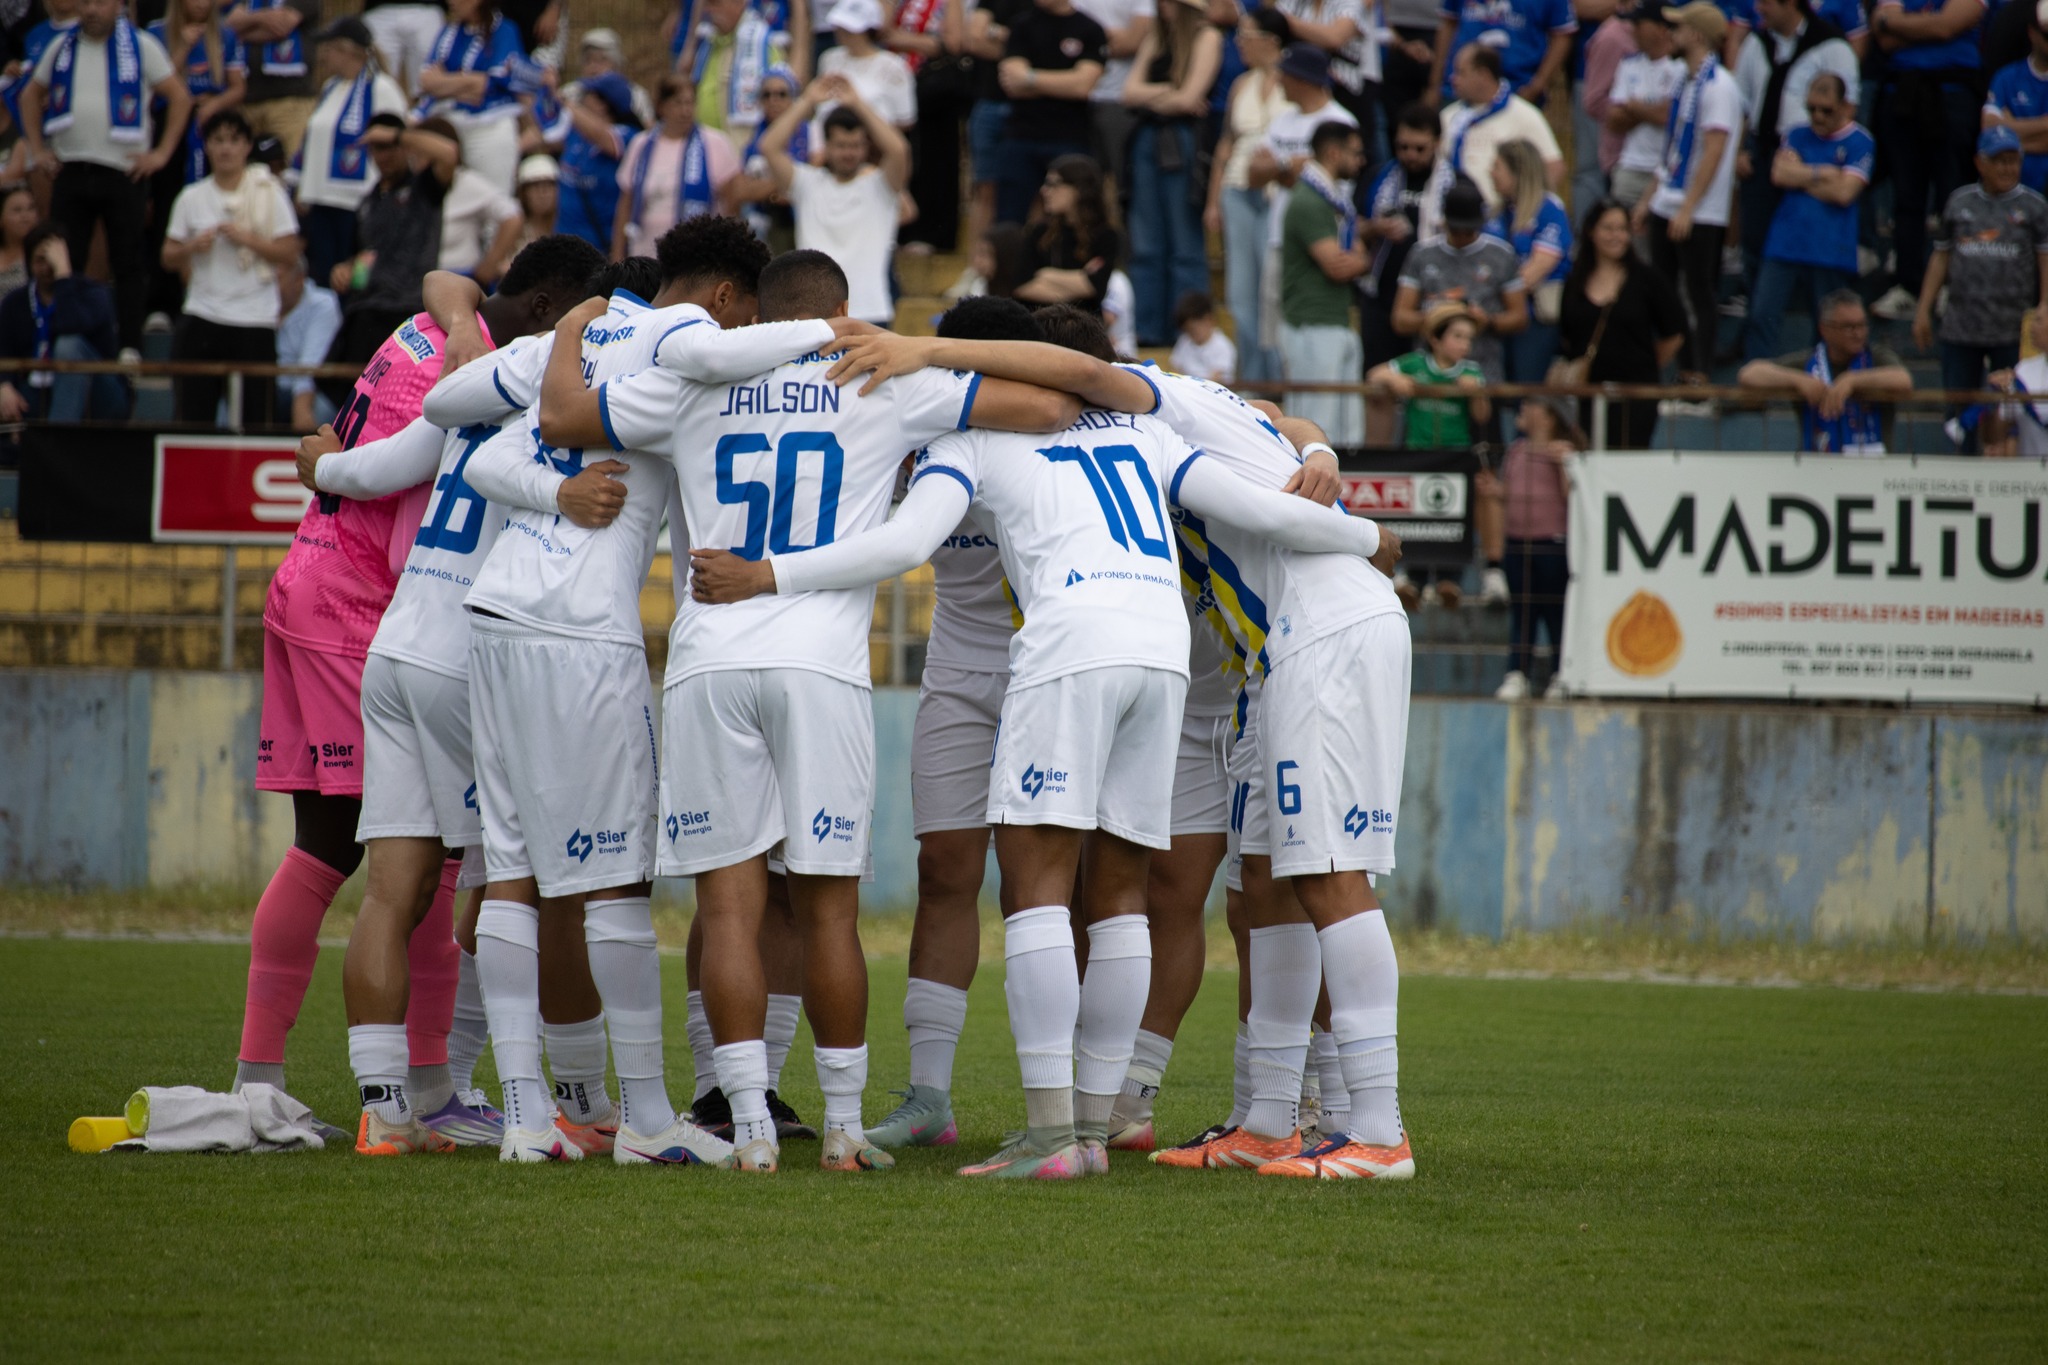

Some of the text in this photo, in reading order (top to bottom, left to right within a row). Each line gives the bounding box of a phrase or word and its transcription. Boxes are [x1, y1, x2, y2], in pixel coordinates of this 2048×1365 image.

[719, 378, 840, 416] JAÍLSON
[715, 431, 844, 562] 50
[1034, 444, 1172, 563] 10
[1604, 493, 2048, 582] MADEITU
[1090, 571, 1133, 580] AFONSO
[1714, 602, 2045, 628] #SOMOS ESPECIALISTAS EM MADEIRAS
[322, 742, 354, 757] Sier
[323, 760, 354, 769] Energia
[1276, 760, 1302, 816] 6
[680, 810, 710, 827] Sier
[834, 816, 855, 831] Sier
[1372, 809, 1393, 823] Sie
[596, 830, 628, 844] Sier
[683, 825, 713, 837] Energia
[832, 832, 853, 842] Energia
[598, 845, 627, 854] Energia
